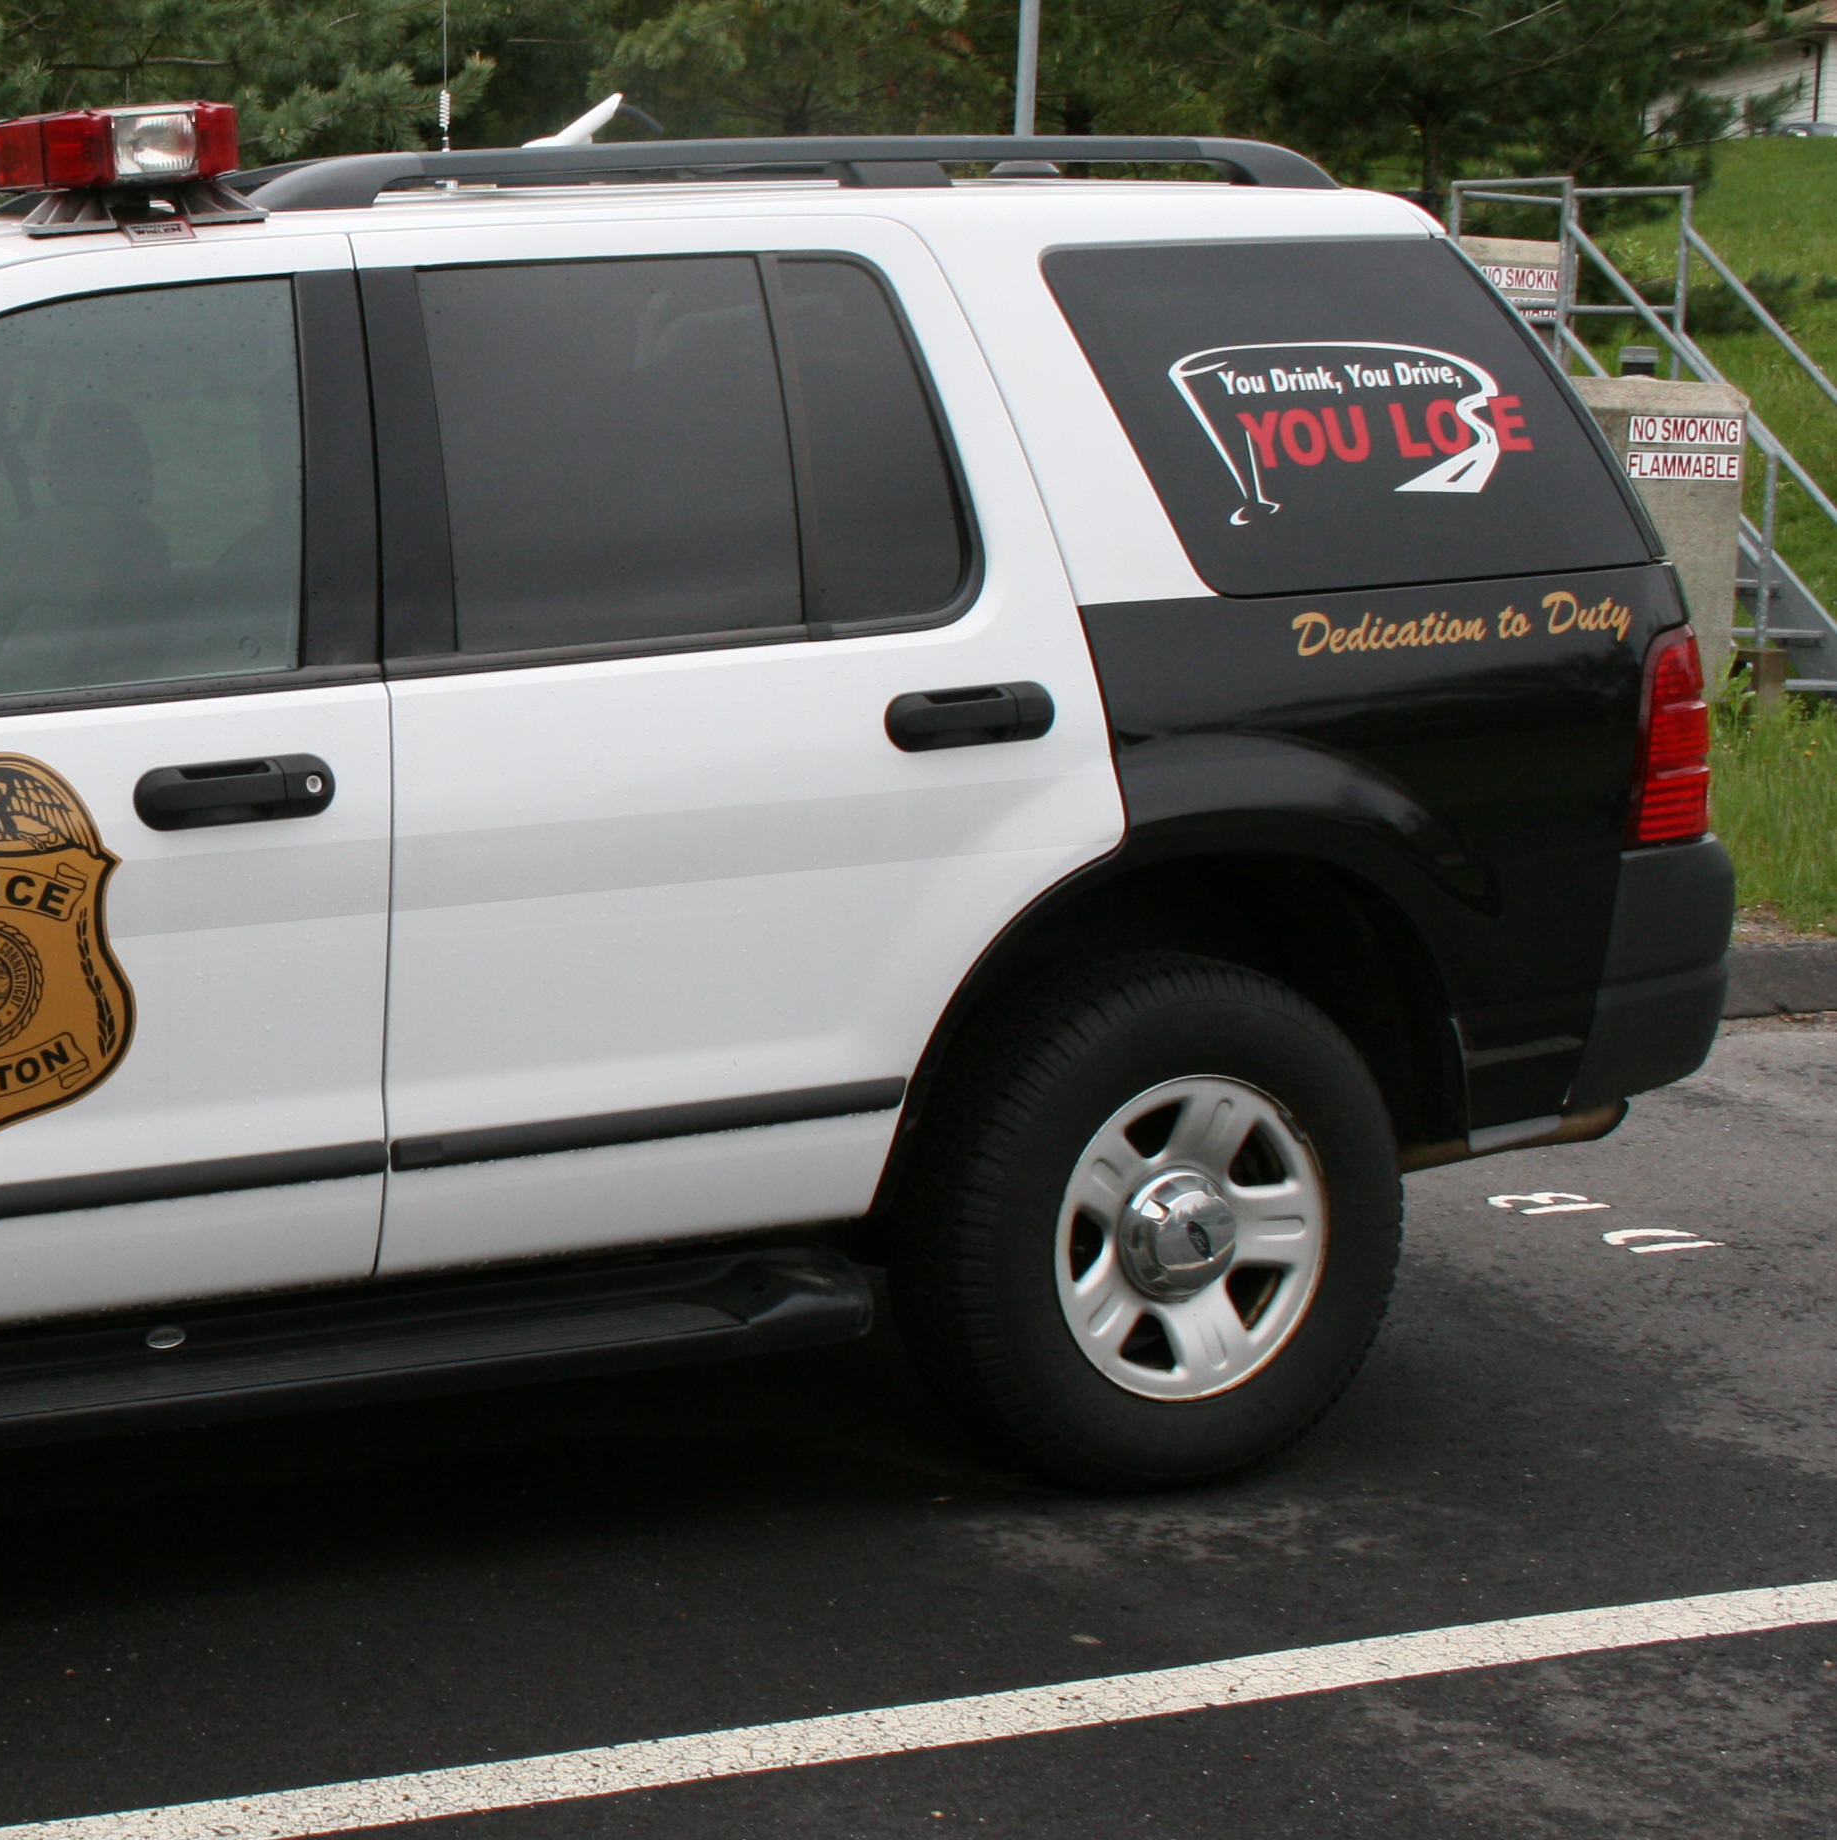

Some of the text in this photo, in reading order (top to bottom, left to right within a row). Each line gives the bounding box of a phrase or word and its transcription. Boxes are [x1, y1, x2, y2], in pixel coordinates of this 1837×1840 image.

[1505, 268, 1560, 289] SMOKIN
[1218, 361, 1463, 395] You Drink, You Drive,
[1236, 404, 1372, 469] YOU
[1633, 417, 1738, 443] NO SMOKING
[1628, 454, 1737, 478] FLAMMABLE
[1292, 591, 1632, 656] Dedication to Duty
